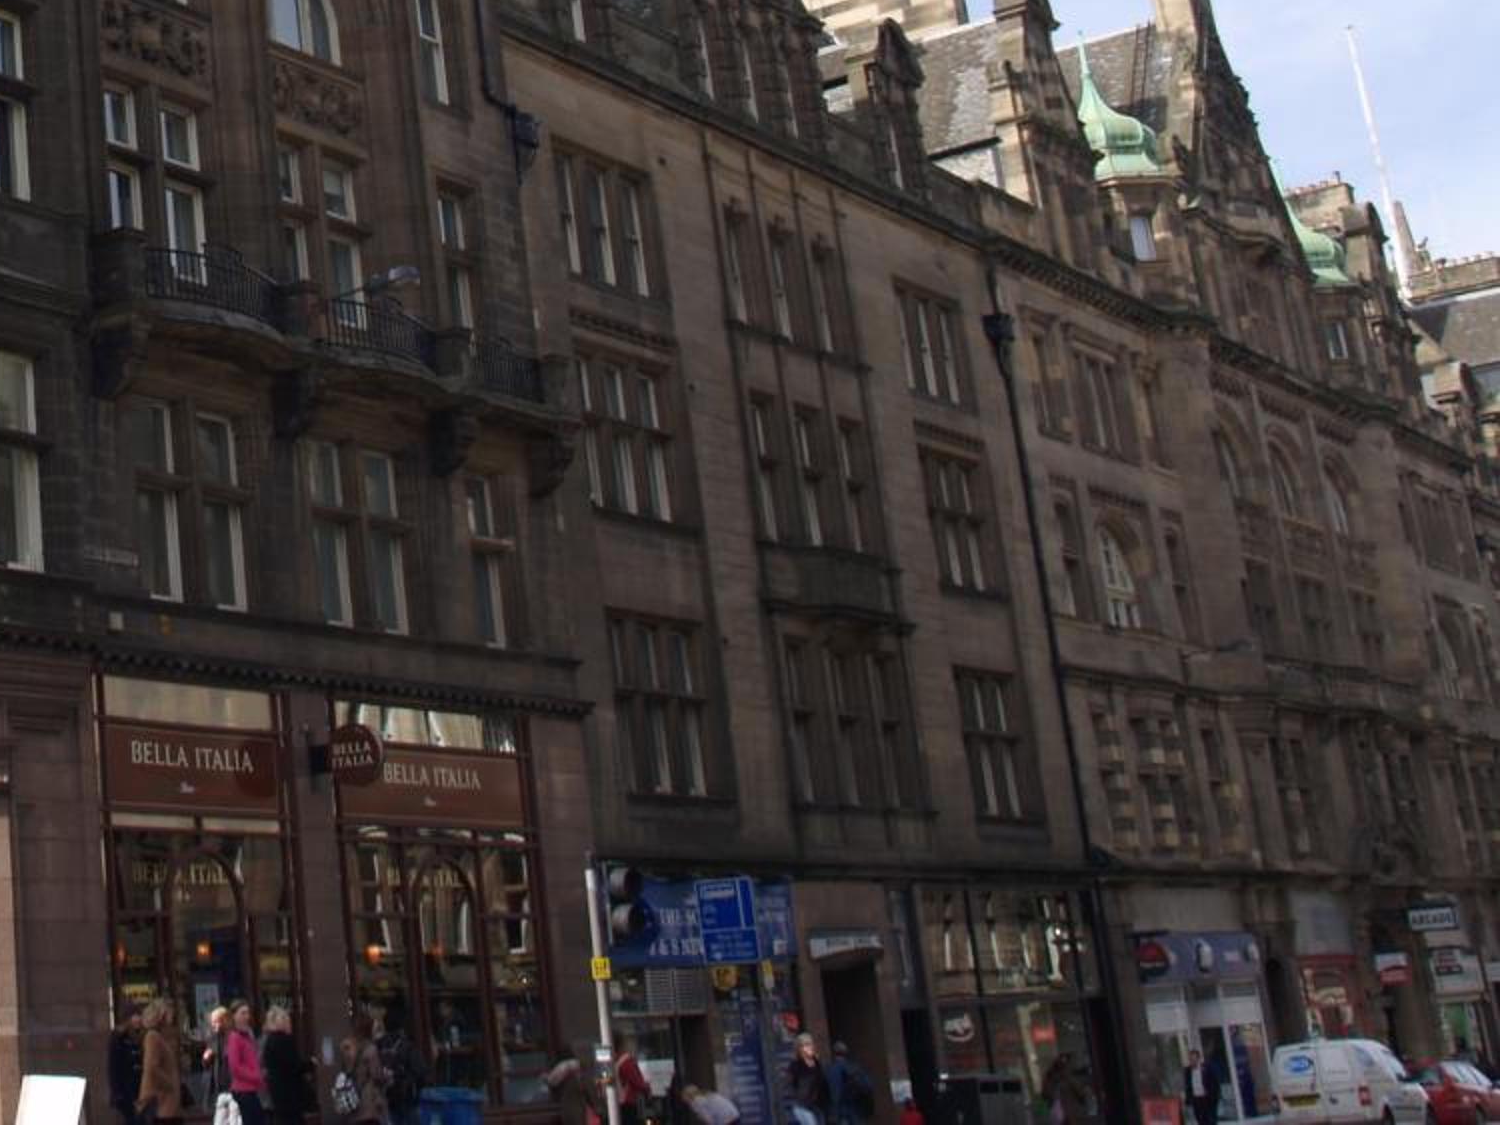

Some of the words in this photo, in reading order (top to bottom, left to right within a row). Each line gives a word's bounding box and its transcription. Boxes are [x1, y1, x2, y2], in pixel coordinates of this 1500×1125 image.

[131, 740, 189, 768] BELLA
[195, 747, 253, 773] ITALIA
[383, 762, 429, 787] BELLA
[433, 766, 481, 790] ITALIA
